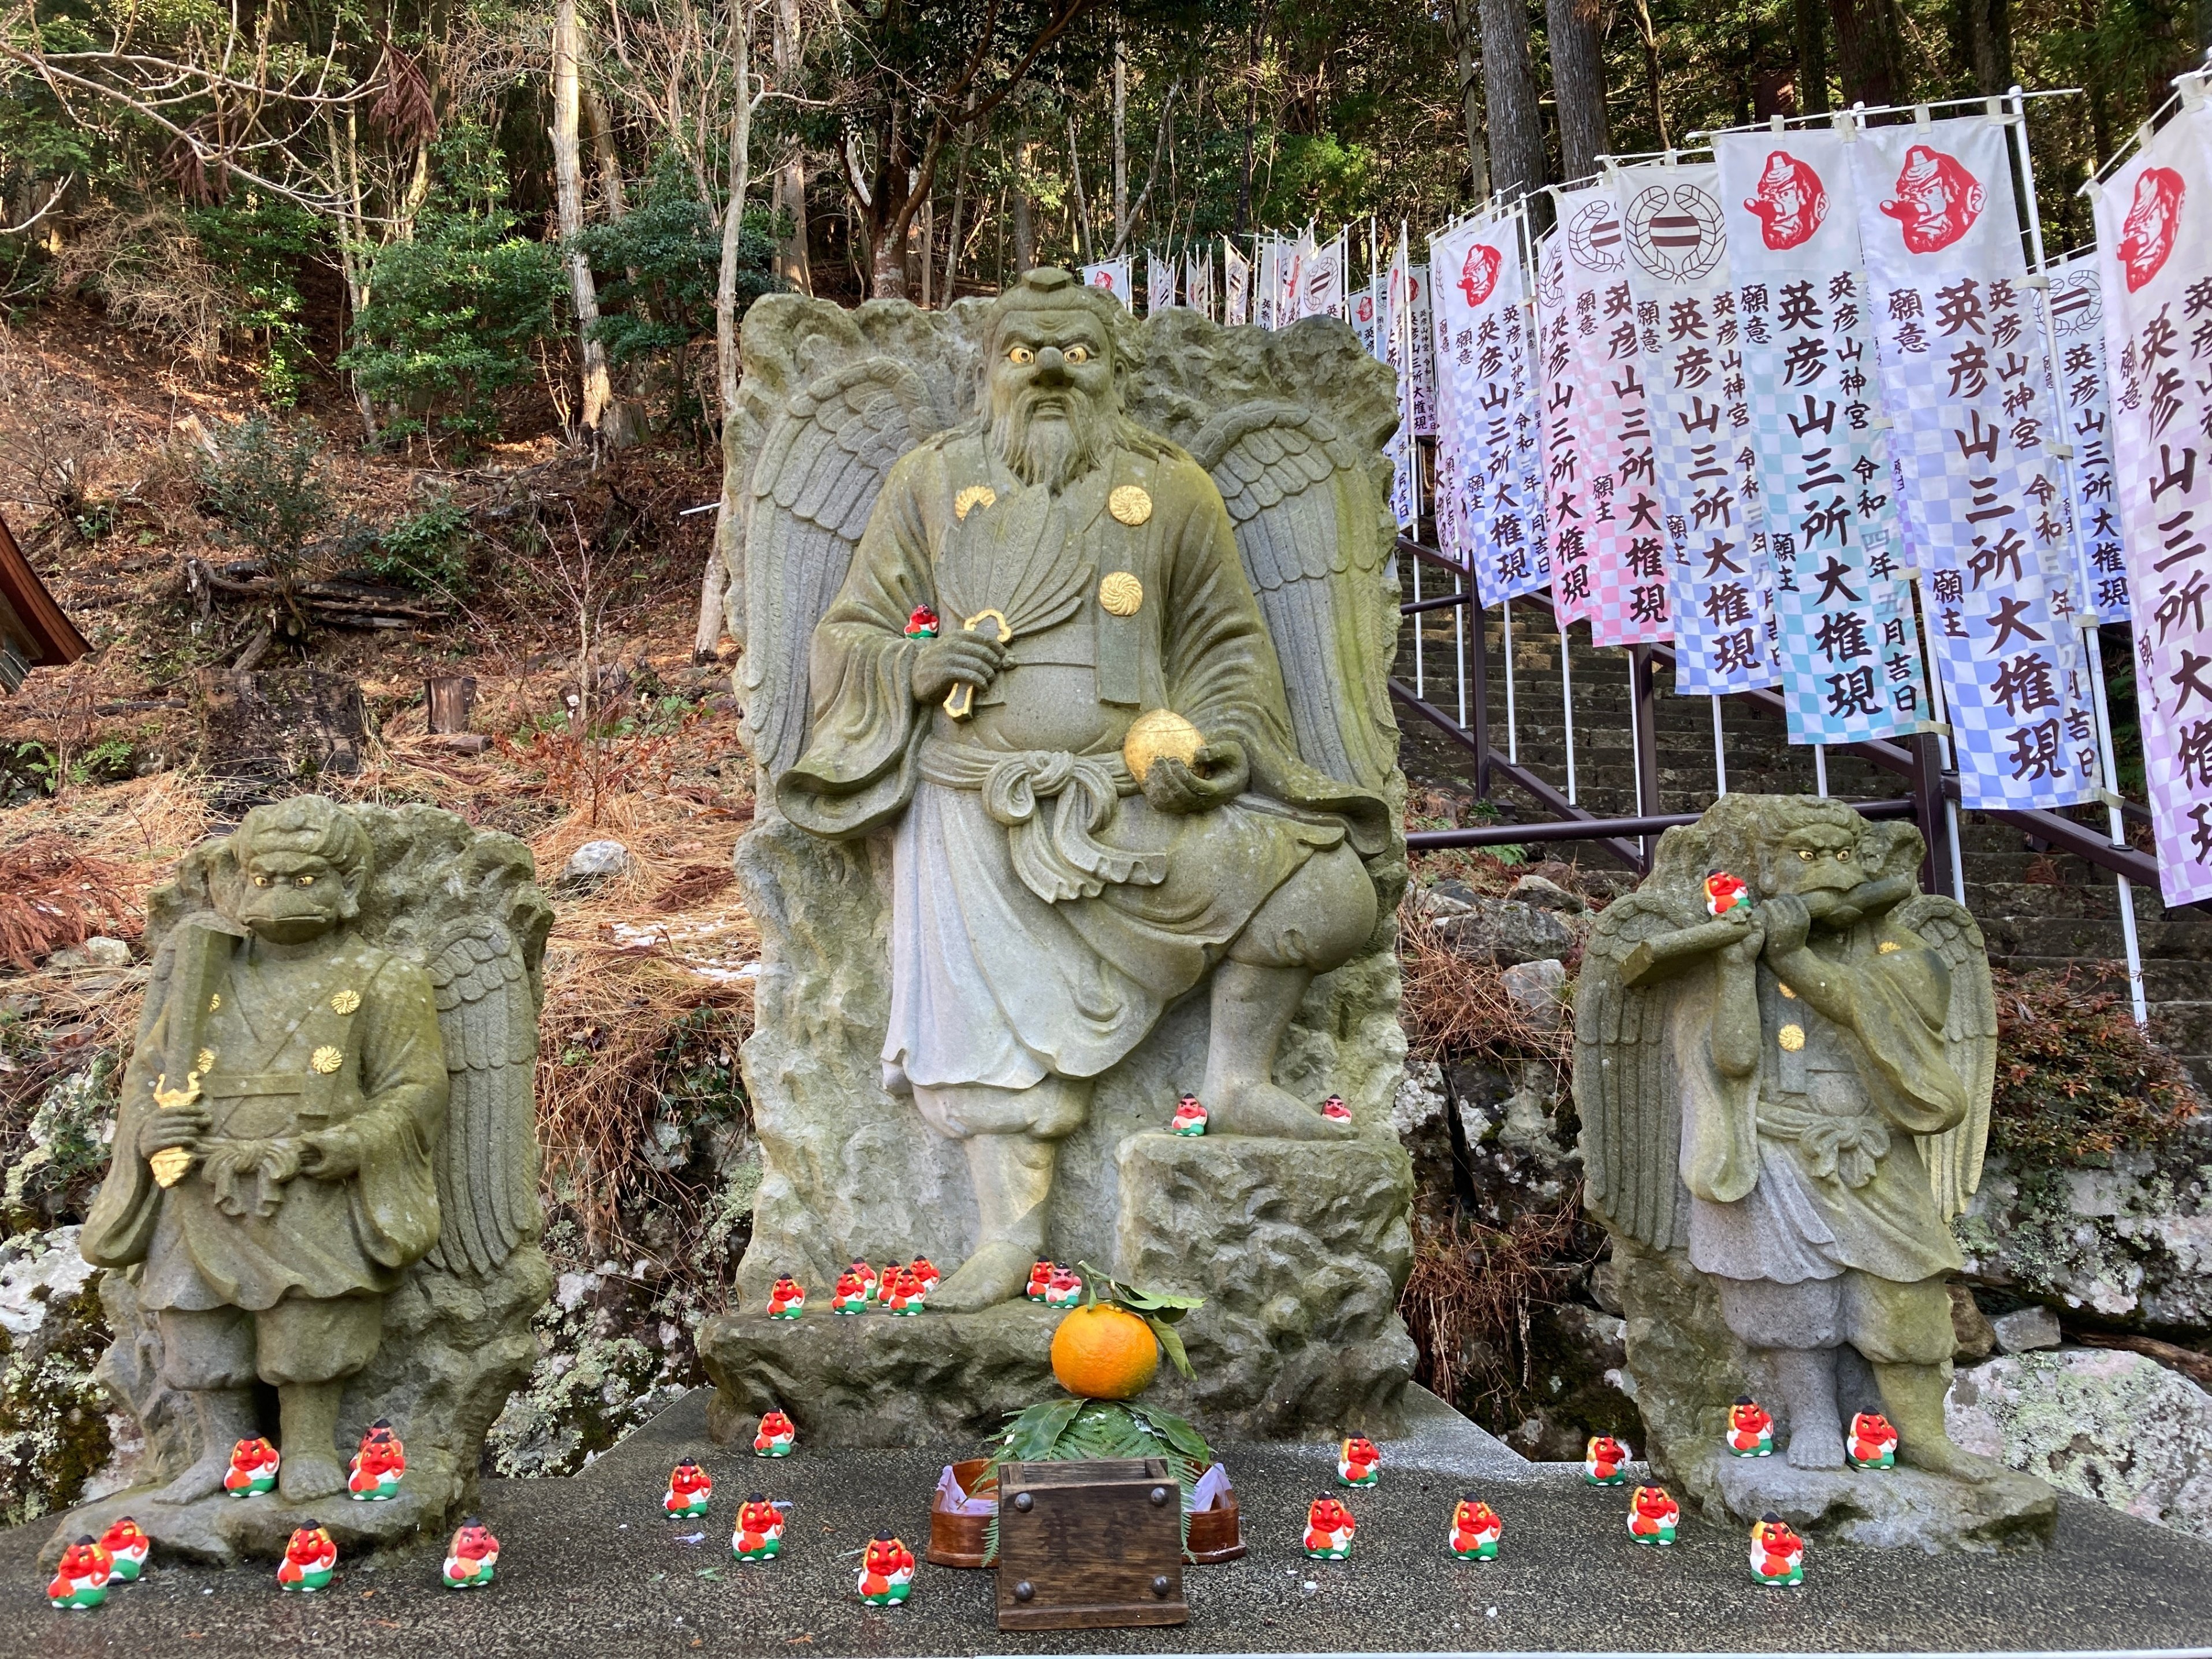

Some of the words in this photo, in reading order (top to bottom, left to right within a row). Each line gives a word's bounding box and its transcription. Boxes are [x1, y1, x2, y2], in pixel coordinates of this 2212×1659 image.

[1455, 328, 1473, 366] 願意
[1502, 304, 1526, 400] 英彦山神宮
[1576, 289, 1599, 339] 願意
[1637, 300, 1663, 353] 願意
[1712, 291, 1750, 429] 英彦山神宮
[1741, 283, 1772, 344] 願意
[1887, 288, 1931, 355] 願意
[1988, 278, 2043, 451] 英彦山神宮
[1467, 473, 1485, 513] 願主
[1476, 313, 1531, 584] 英彦山三所大権現
[1547, 306, 1591, 605] 英彦山三所大権現
[1603, 280, 1669, 624] 英彦山三所大権現
[1667, 297, 1761, 675] 英彦山三所大権現
[1828, 270, 1871, 430] 英彦山神宮
[1851, 455, 1917, 712] 令和四年五月吉日
[2064, 343, 2130, 608] 英彦山三所大権現
[1592, 474, 1616, 524] 願主
[1666, 514, 1691, 566] 願主
[1777, 280, 1883, 719] 英彦山三所大権現
[1935, 278, 2067, 782] 英彦山三所大権現
[1771, 533, 1800, 592] 願主
[1932, 568, 1970, 638] 願主
